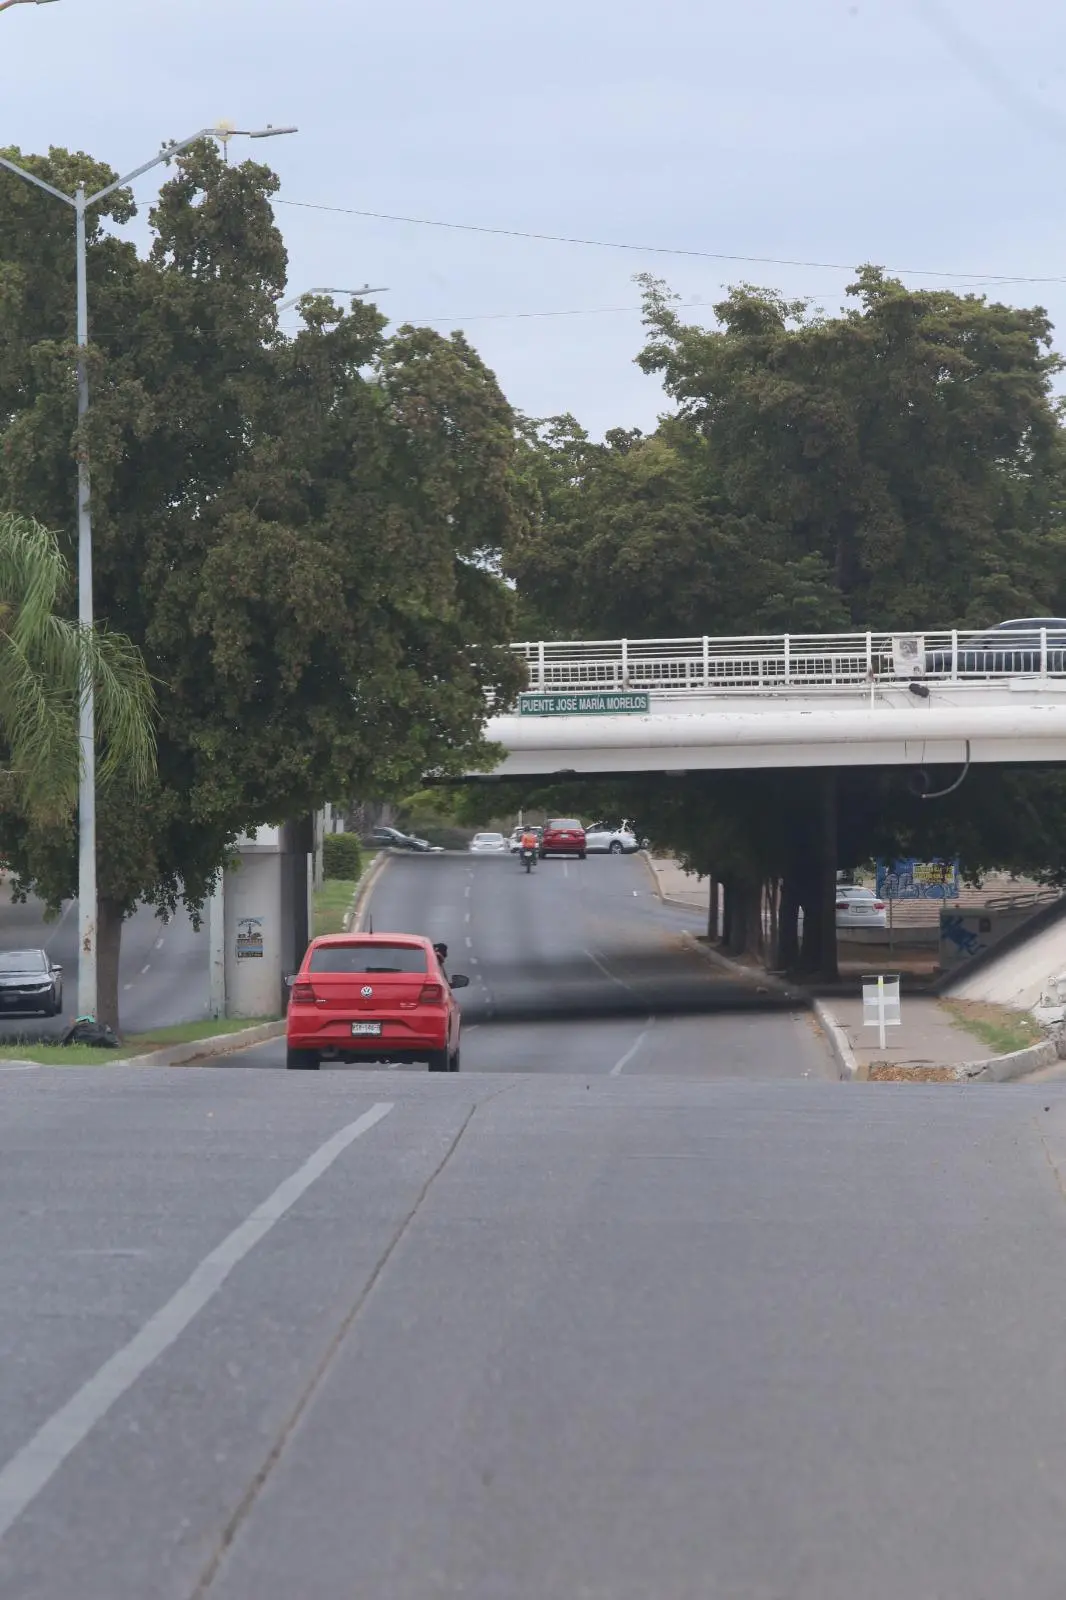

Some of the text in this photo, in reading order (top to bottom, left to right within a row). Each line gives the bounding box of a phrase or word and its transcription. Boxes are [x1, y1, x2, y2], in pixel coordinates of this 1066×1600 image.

[522, 695, 646, 712] PUENTE JOSÉ MARÍA MORELOS
